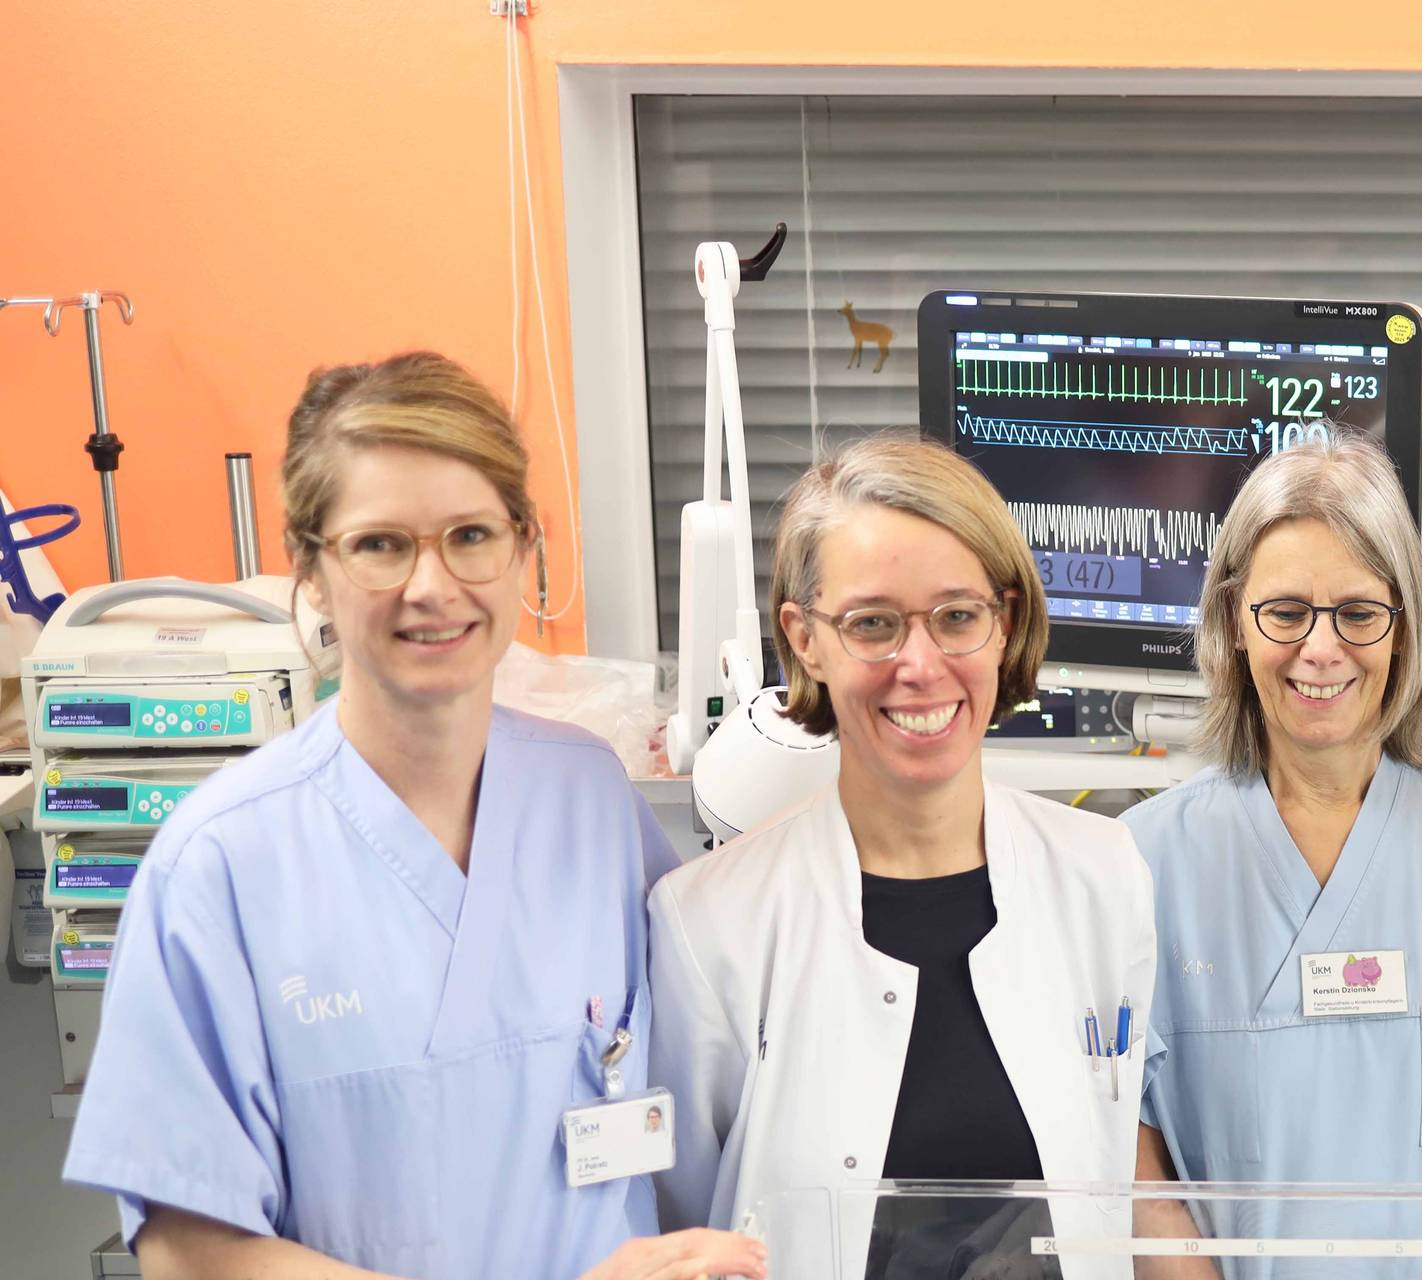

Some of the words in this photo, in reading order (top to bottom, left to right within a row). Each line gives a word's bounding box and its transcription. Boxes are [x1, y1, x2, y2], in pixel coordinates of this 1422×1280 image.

[1303, 305, 1338, 314] IntelliVue
[1345, 307, 1378, 316] MX800
[1265, 377, 1324, 418] 122
[1344, 375, 1378, 399] 123
[1066, 560, 1114, 590] (47)
[1142, 643, 1182, 654] PHILIPS
[1183, 960, 1214, 977] KM
[1311, 966, 1332, 975] UKM
[1313, 987, 1340, 995] Kerstin
[295, 989, 363, 1025] UKM
[575, 1123, 600, 1137] UKM
[1183, 1242, 1199, 1253] 10
[1256, 1243, 1264, 1253] 5
[1325, 1243, 1334, 1253] 0
[1395, 1243, 1404, 1253] 5
